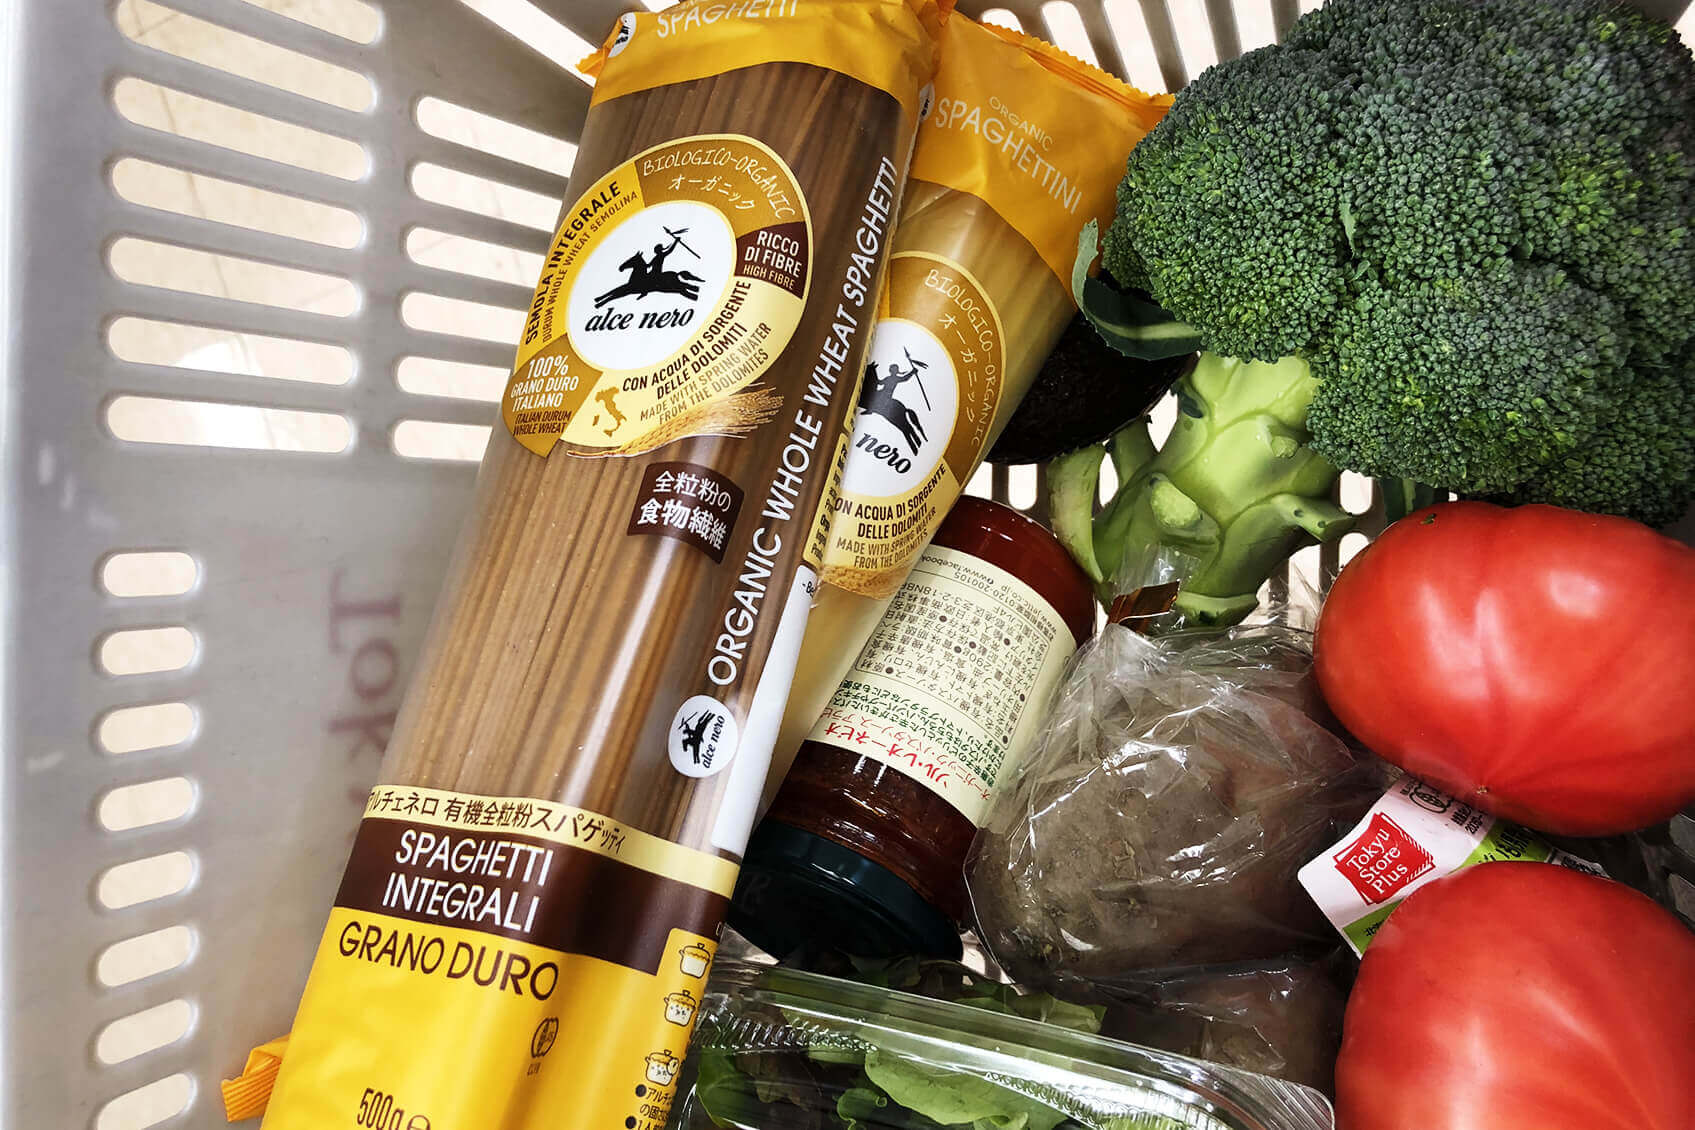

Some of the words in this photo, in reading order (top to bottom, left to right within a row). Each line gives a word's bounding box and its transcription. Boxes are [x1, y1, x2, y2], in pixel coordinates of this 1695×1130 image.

[988, 95, 1054, 151] ORGANIC
[935, 97, 1083, 214] SPAGHETTINI
[668, 174, 755, 209] オーガニック
[525, 274, 554, 345] SEMOLA
[548, 181, 621, 268] INTEGRALE
[549, 269, 568, 305] WHOLE
[563, 232, 591, 266] WHEAT
[590, 191, 638, 232] SEMOLINA
[744, 246, 760, 263] DI
[762, 250, 802, 278] FIBRE
[756, 230, 800, 257] RICCO
[743, 264, 767, 278] HIGH
[768, 270, 796, 291] FIBRE
[584, 307, 634, 332] alce
[638, 308, 695, 329] nero
[622, 375, 648, 392] CON
[651, 353, 691, 387] ACQUA
[689, 340, 705, 357] DI
[702, 280, 752, 343] SORGENTE
[527, 355, 568, 379] 100%
[640, 402, 668, 421] MADE
[669, 381, 699, 405] WITH
[699, 351, 740, 385] SPRING
[738, 322, 772, 360] WATER
[656, 368, 691, 400] DELLE
[691, 322, 748, 375] DOLOMITI
[510, 378, 545, 399] GRANO
[545, 375, 579, 392] DURO
[512, 392, 564, 412] ITALIANO
[659, 403, 688, 425] FROM
[690, 389, 713, 406] THE
[711, 348, 769, 393] DOLOMITES
[512, 423, 538, 436] WHOLE
[538, 422, 567, 434] WHEAT
[515, 411, 543, 425] ITALIAN
[541, 410, 573, 422] DURUM
[707, 525, 782, 686] ORGANIC
[765, 408, 823, 523] WHOLE
[804, 303, 857, 407] WHEAT
[843, 156, 899, 308] SPAGHETTI
[855, 432, 912, 474] nero
[653, 470, 732, 512] 全粒粉の
[834, 498, 853, 515] ON
[854, 503, 893, 521] ACQUA
[896, 503, 906, 518] DI
[907, 464, 947, 513] SORGENTE
[636, 497, 728, 550] 食物繊維
[857, 522, 889, 539] DELLE
[891, 502, 928, 538] DOLOMITI
[836, 537, 866, 555] MADE
[868, 543, 890, 556] WITH
[853, 556, 879, 569] FROM
[879, 554, 893, 568] THE
[701, 743, 716, 769] alce
[823, 721, 947, 788] ソル・レオーネビオ
[443, 796, 626, 854] 有機全粒粉スパゲッティ
[394, 828, 555, 886] SPAGHETTI
[1346, 828, 1390, 871] Tokyu
[1360, 847, 1401, 884] Store
[1371, 864, 1408, 894] Plus
[382, 871, 541, 934] INTEGRALI
[338, 921, 444, 976] GRANO
[447, 939, 560, 1002] DURO
[357, 1087, 405, 1130] 500g
